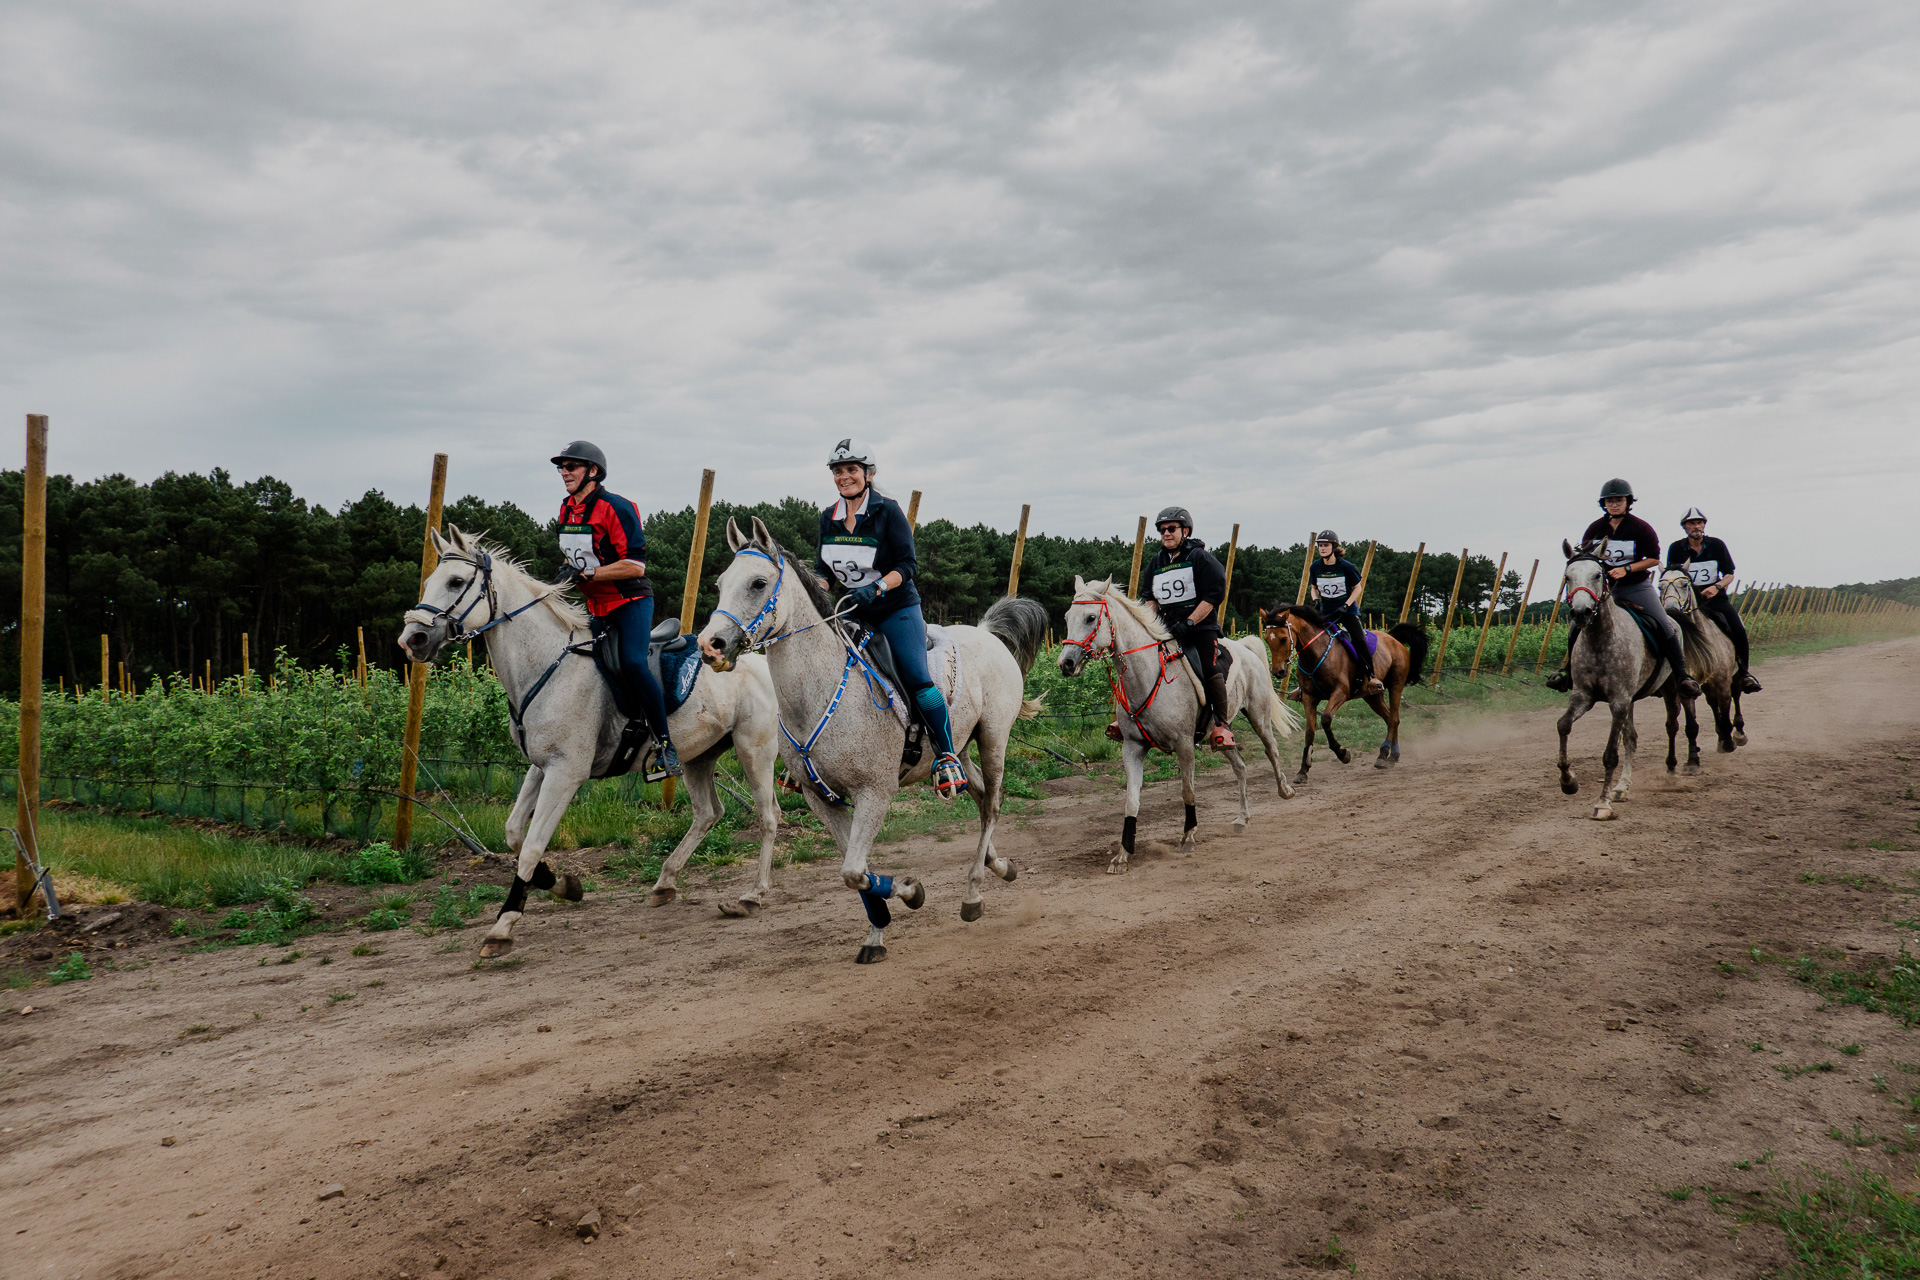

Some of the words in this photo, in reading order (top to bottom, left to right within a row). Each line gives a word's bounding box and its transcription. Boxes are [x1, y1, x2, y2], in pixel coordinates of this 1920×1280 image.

[832, 560, 865, 583] 53
[1689, 568, 1710, 583] 73
[1161, 579, 1185, 600] 59
[1322, 584, 1340, 596] 62
